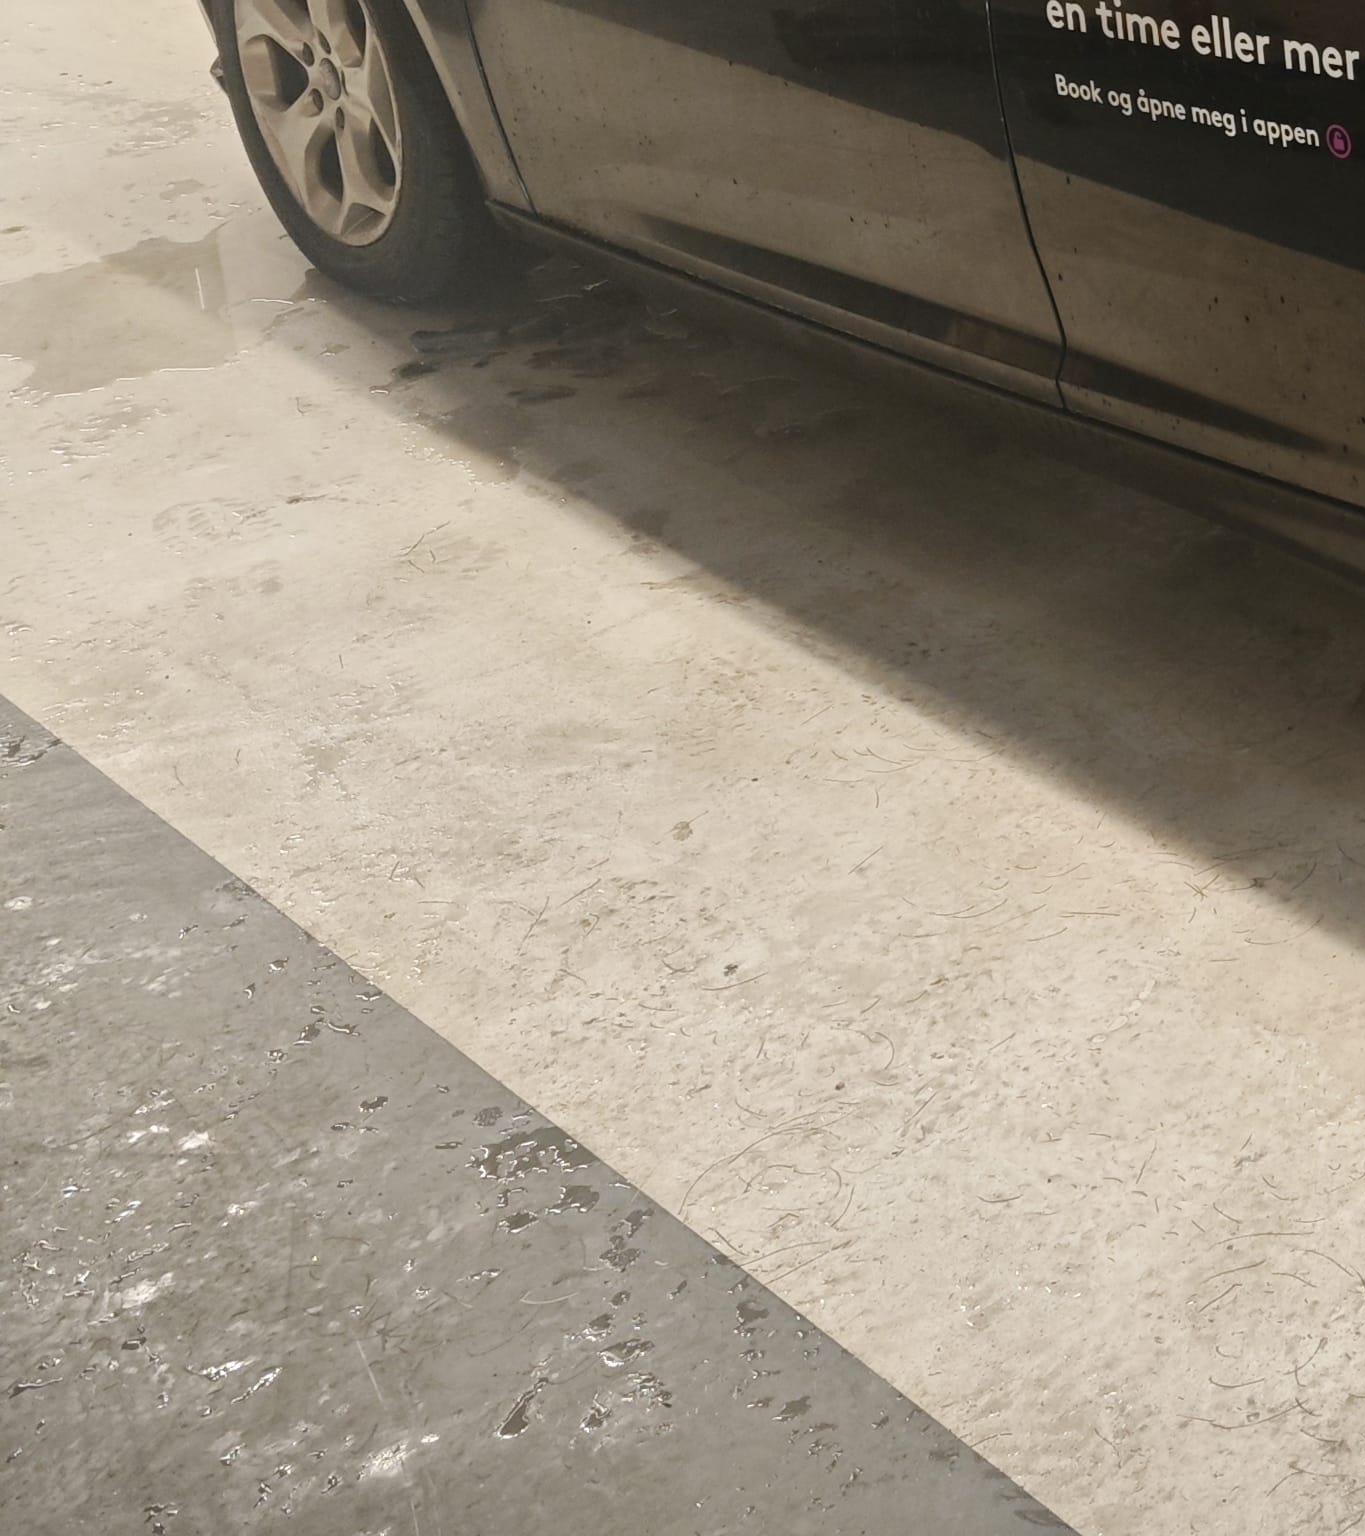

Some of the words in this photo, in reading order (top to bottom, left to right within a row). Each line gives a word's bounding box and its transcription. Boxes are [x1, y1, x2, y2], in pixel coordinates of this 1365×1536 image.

[1046, 0, 1087, 33] en
[1191, 14, 1270, 65] eller
[1283, 38, 1360, 81] mer
[1054, 72, 1103, 105] Book
[1107, 88, 1133, 116] og
[1137, 88, 1187, 121] åpne
[1191, 105, 1236, 137] meg
[1239, 108, 1249, 133] i
[1253, 118, 1320, 148] appen
